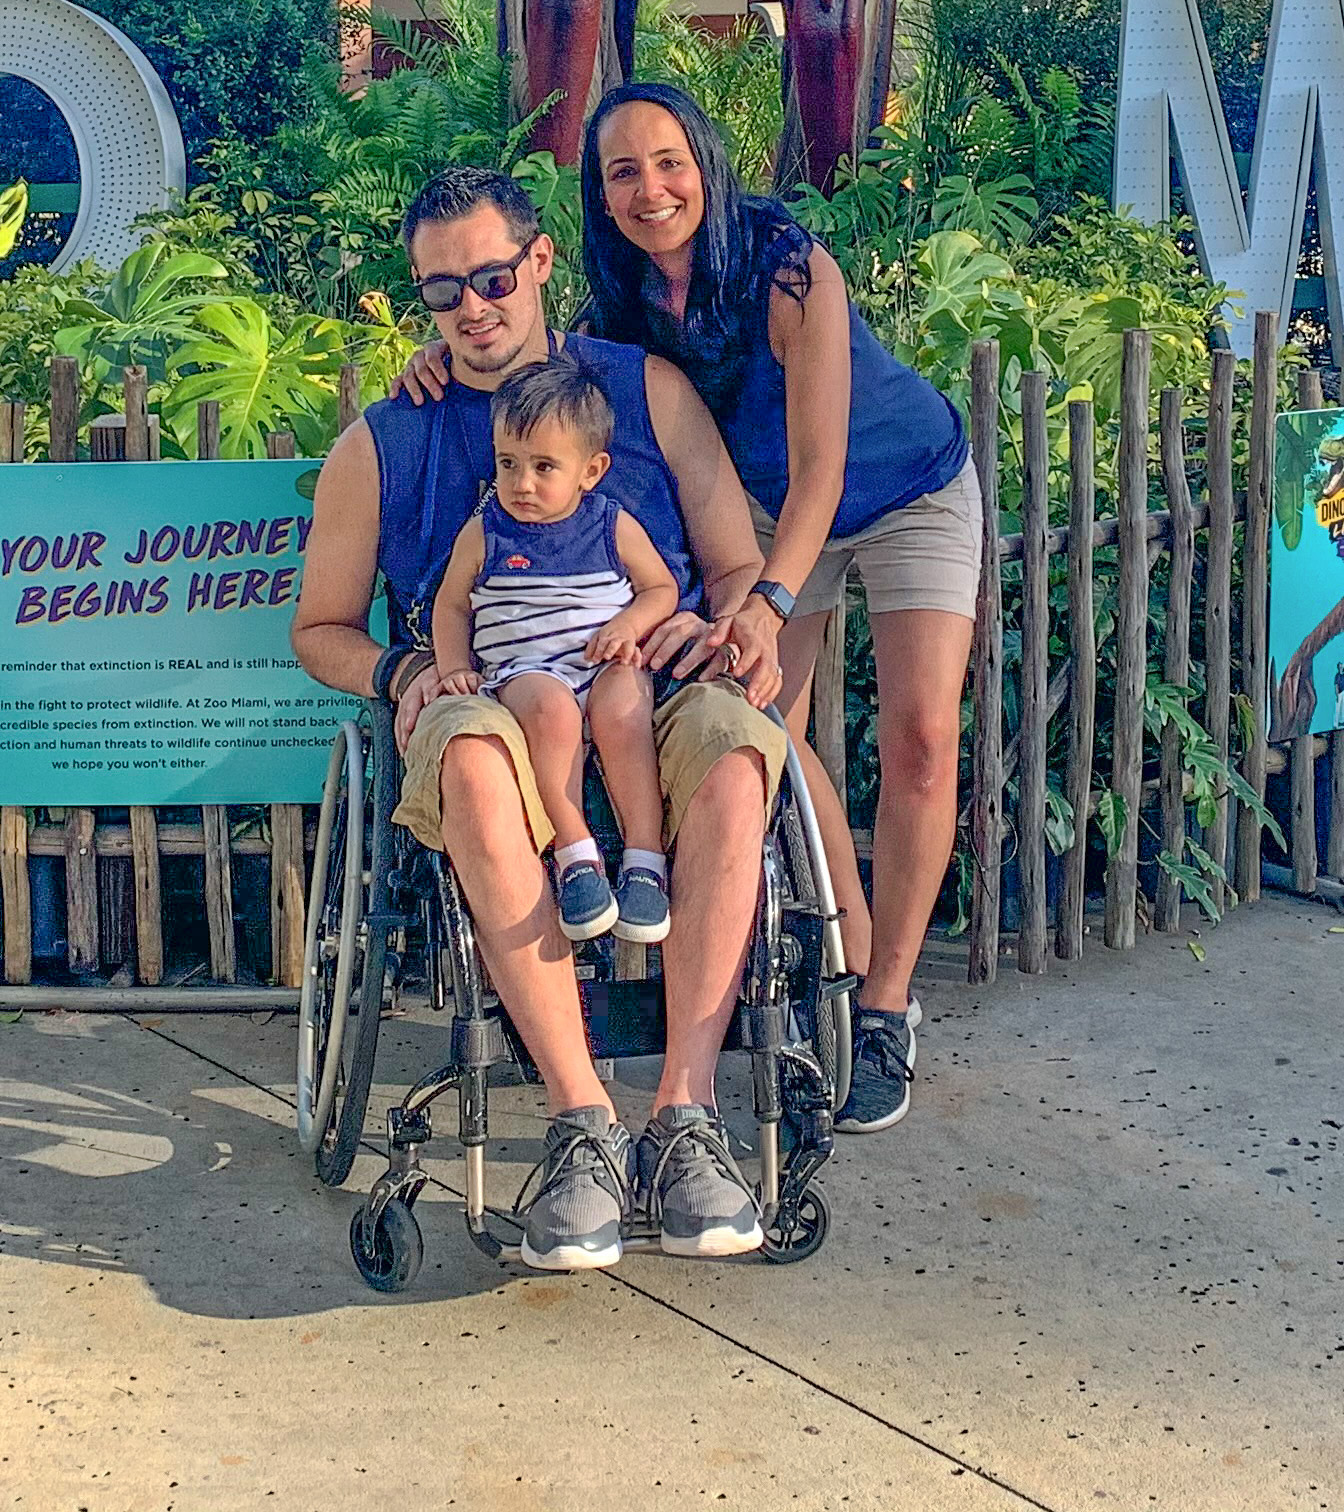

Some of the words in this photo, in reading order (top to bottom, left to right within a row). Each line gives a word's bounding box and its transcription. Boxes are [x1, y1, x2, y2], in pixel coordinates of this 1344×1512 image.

[473, 487, 497, 515] CHAPEL
[1, 531, 107, 577] YOUR
[124, 515, 313, 565] JOURNEY
[15, 576, 170, 625] BEGINS
[187, 567, 302, 613] HERE
[1, 660, 57, 672] reminder
[61, 660, 86, 671] that
[89, 660, 151, 671] extinction
[155, 659, 164, 670] is
[168, 659, 203, 670] REAL
[206, 658, 229, 670] and
[233, 658, 243, 669] is
[246, 658, 268, 669] still
[0, 700, 11, 710] in
[15, 700, 34, 710] the
[38, 700, 66, 712] fight
[71, 701, 83, 710] to
[87, 700, 131, 712] protect
[135, 698, 182, 709] wildlife.
[186, 698, 200, 709] At
[204, 698, 227, 709] Zoo
[231, 698, 270, 710] Miami,
[274, 699, 291, 707] we
[294, 699, 313, 707] are
[53, 720, 97, 732] species
[101, 719, 130, 730] from
[134, 718, 197, 729] extinction.
[201, 718, 221, 728] We
[224, 717, 245, 728] will
[249, 718, 269, 728] not
[273, 717, 306, 728] stand
[310, 716, 339, 727] back
[34, 739, 56, 750] and
[60, 739, 101, 749] human
[105, 738, 147, 749] threats
[150, 739, 163, 748] to
[167, 738, 210, 748] wildlife
[214, 737, 267, 748] continue
[271, 736, 336, 747] unchecked
[52, 761, 69, 770] we
[73, 759, 103, 771] hope
[107, 760, 130, 771] you
[133, 759, 167, 769] won't
[170, 758, 207, 769] either.
[565, 866, 594, 884] NAUTICA
[628, 875, 659, 888] NAUTICA
